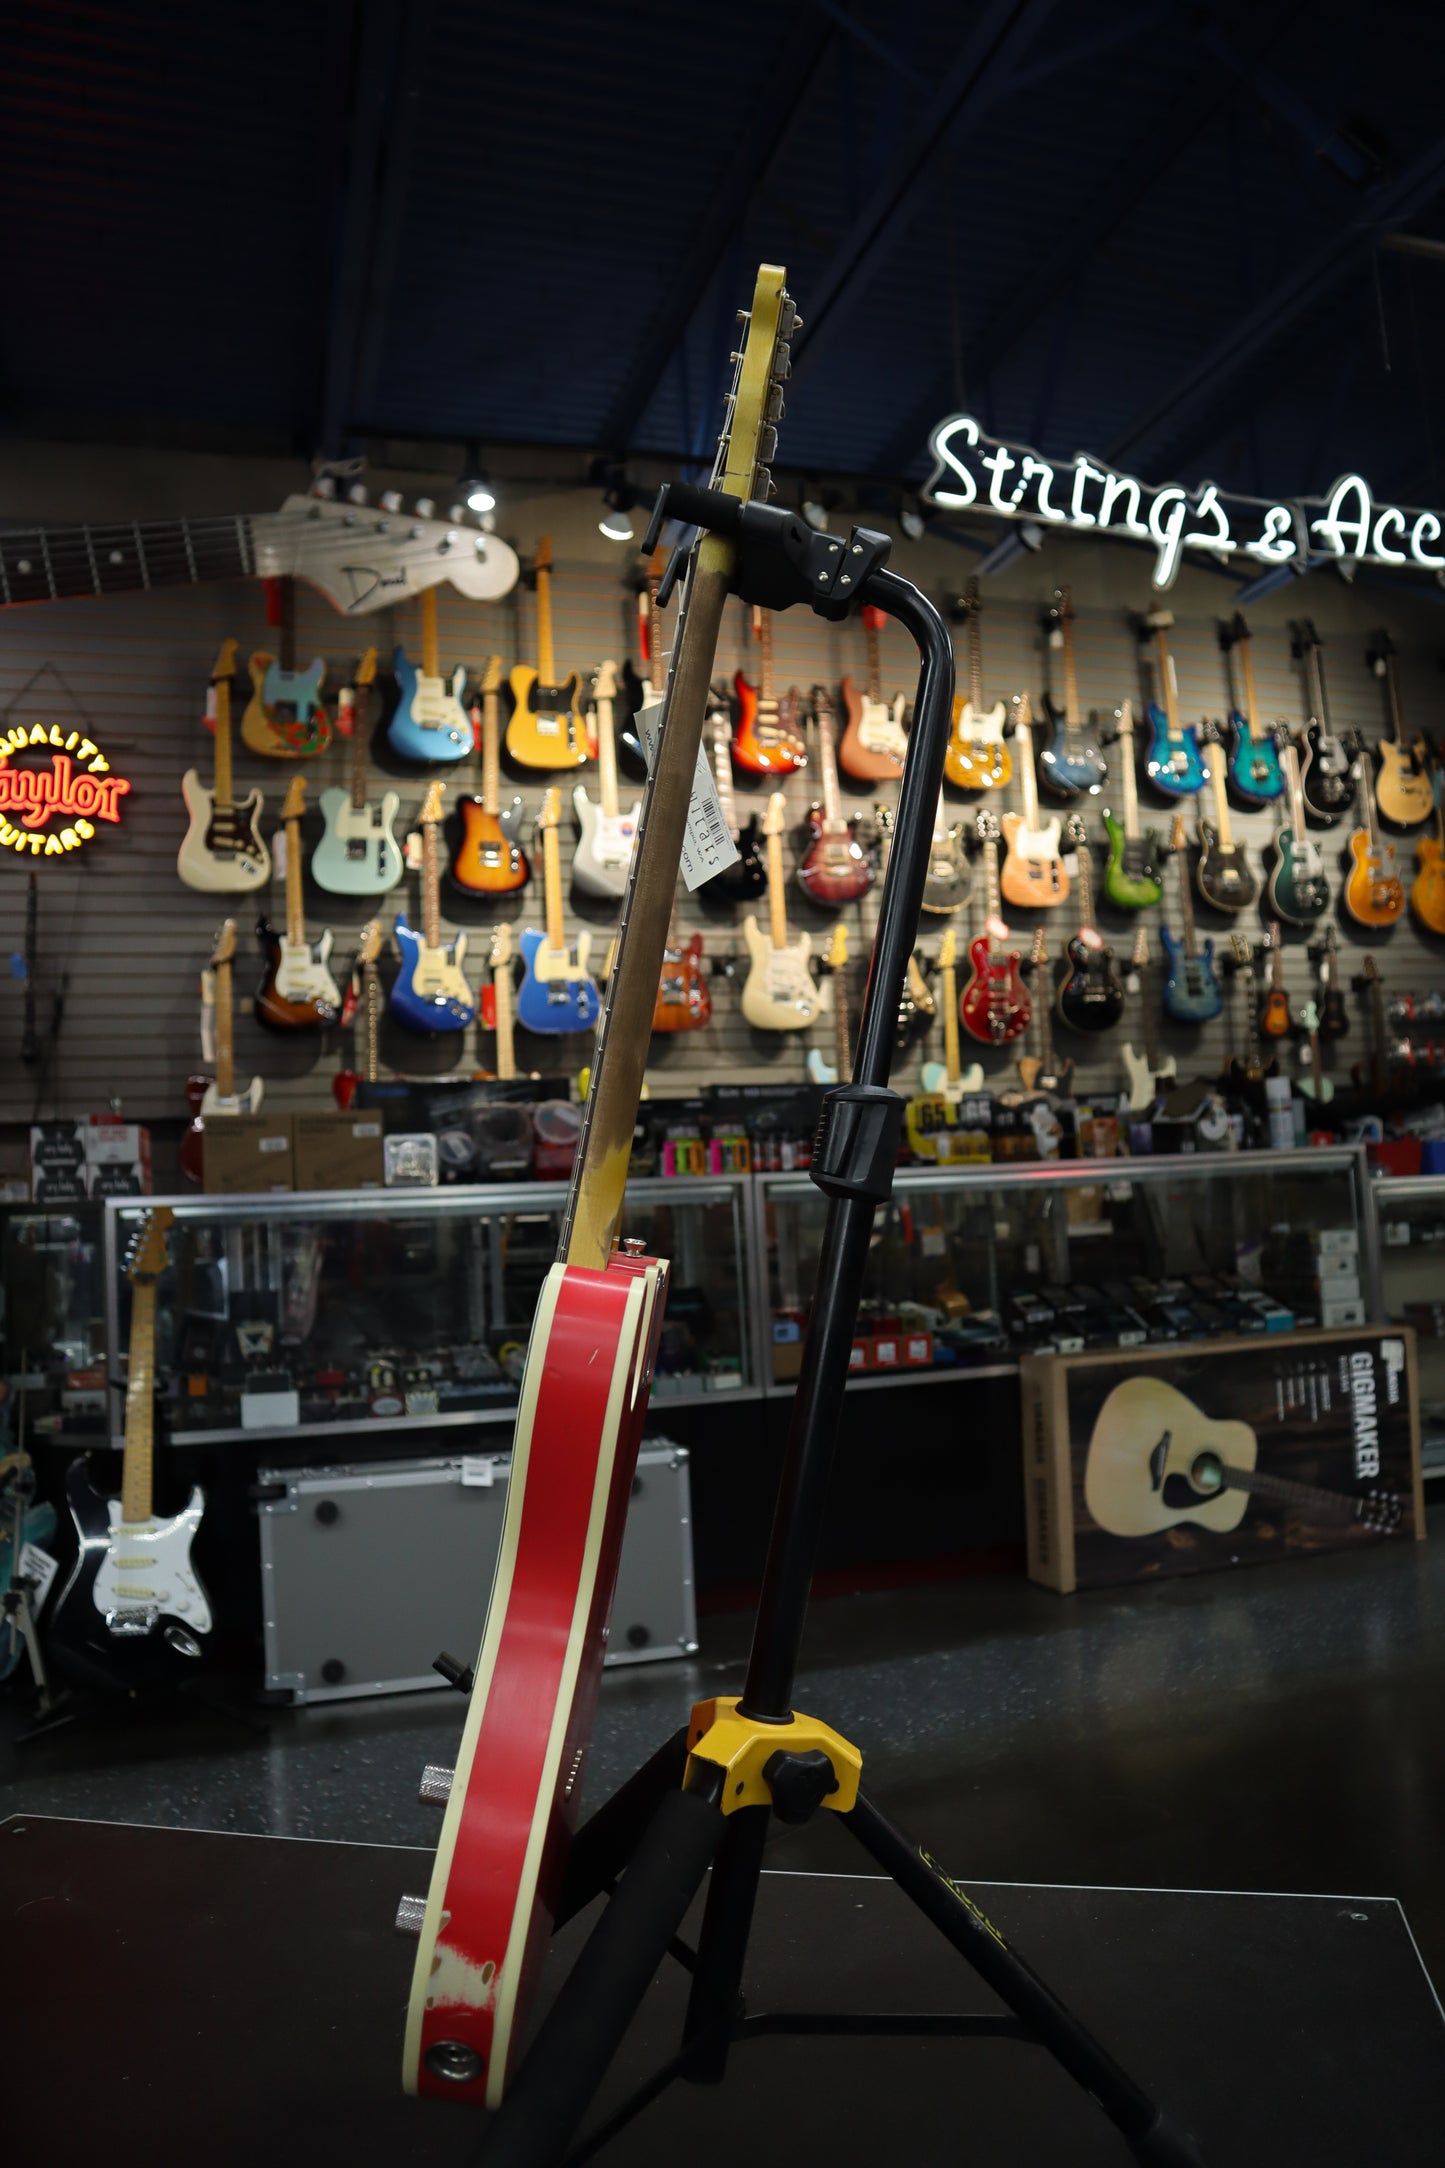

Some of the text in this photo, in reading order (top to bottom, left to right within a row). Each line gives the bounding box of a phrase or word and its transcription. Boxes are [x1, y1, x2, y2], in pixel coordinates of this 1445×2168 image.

[935, 417, 1237, 587] Strings
[1245, 506, 1297, 561] &
[0, 754, 131, 829] aylor
[1352, 1352, 1380, 1479] GIGMAKER
